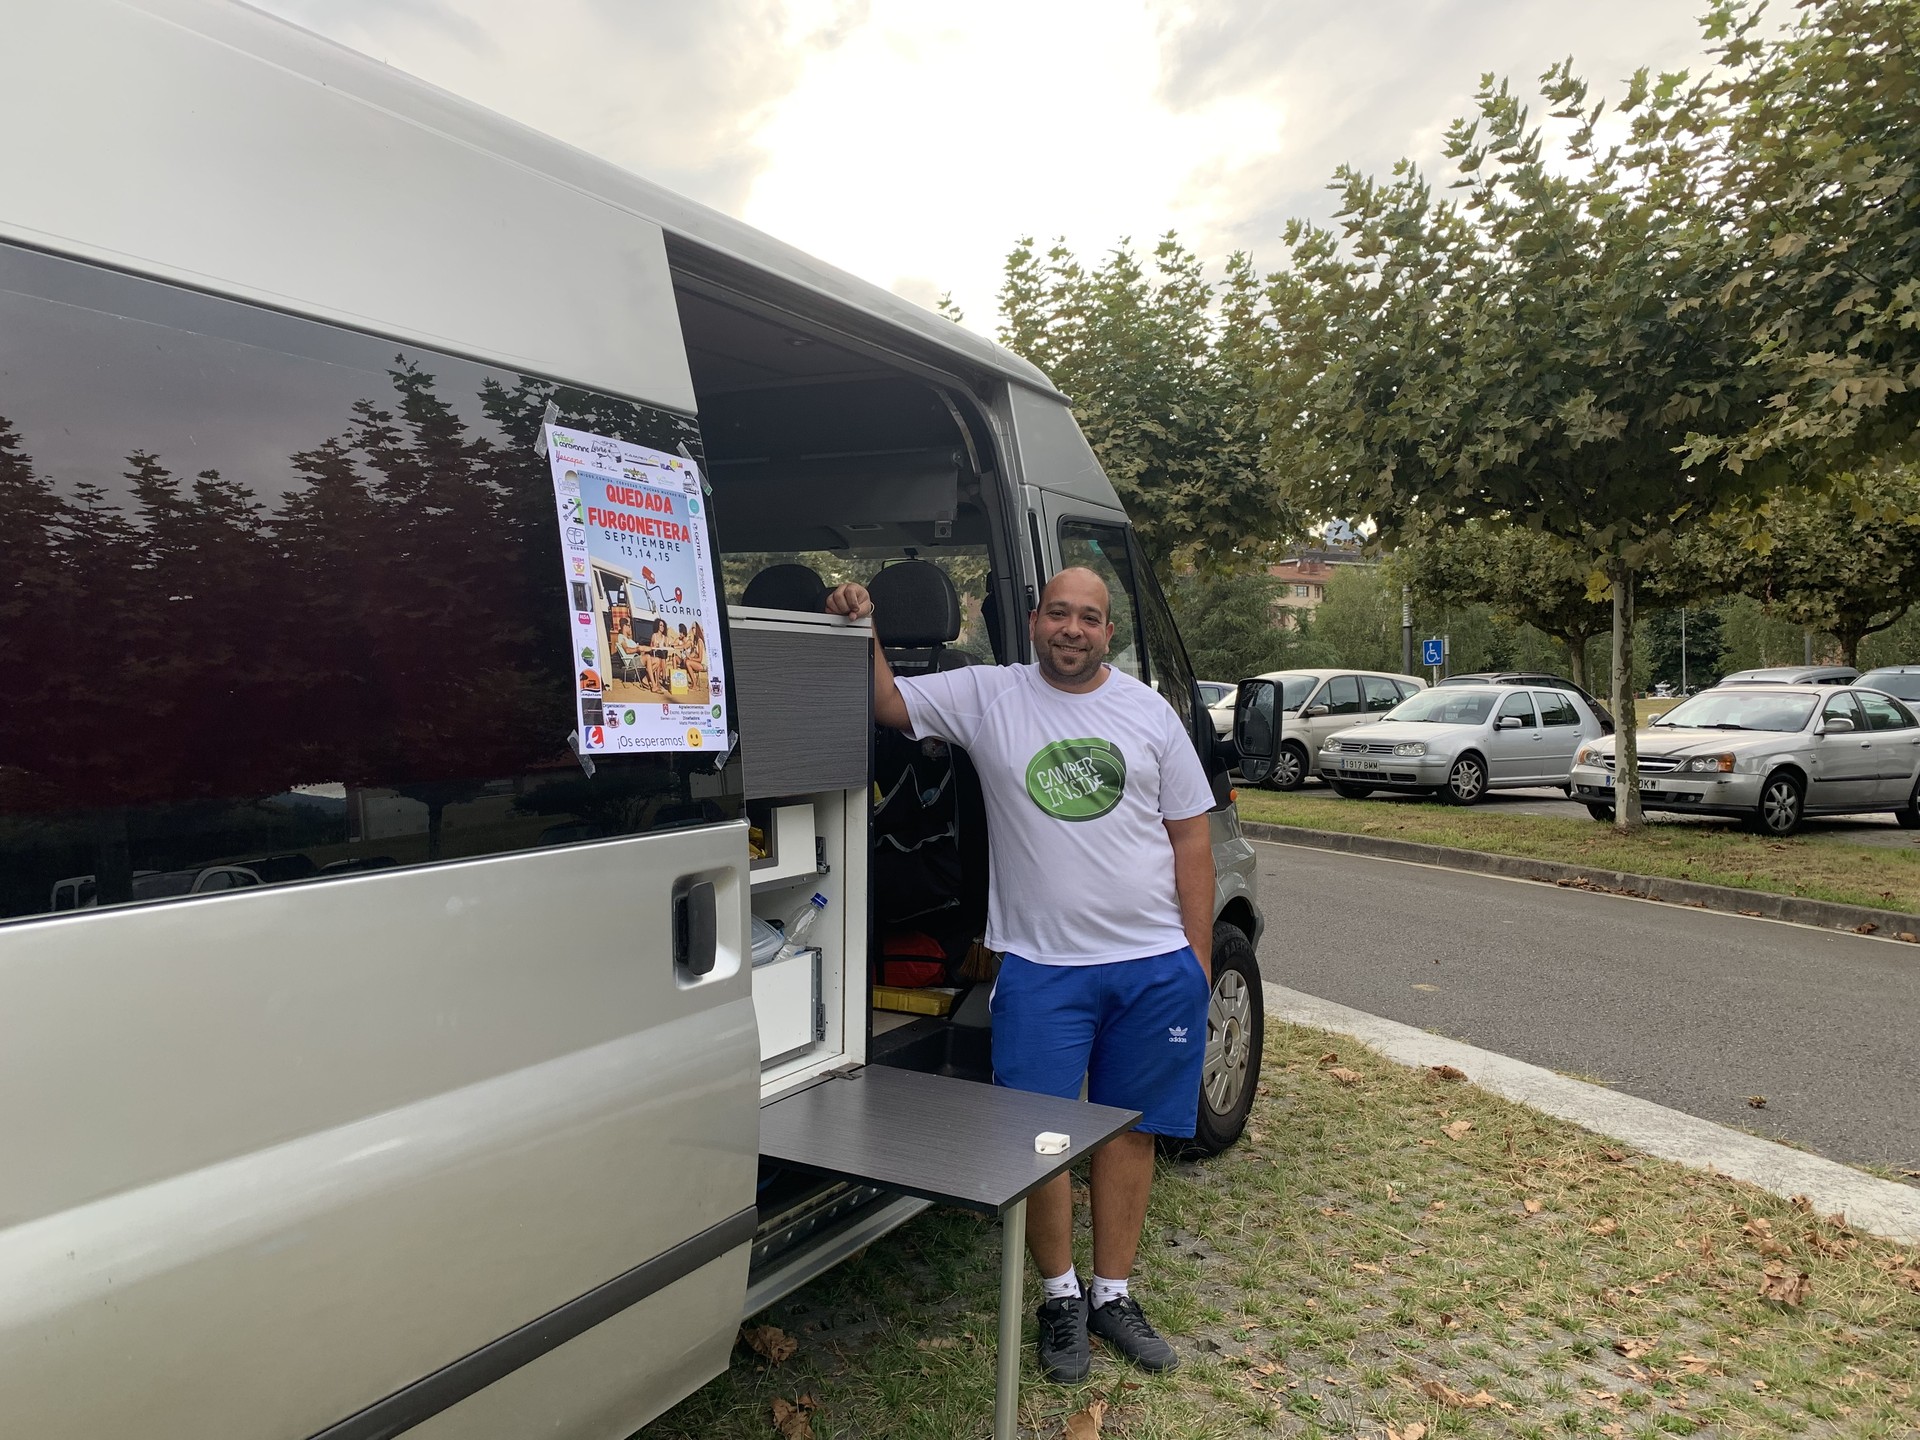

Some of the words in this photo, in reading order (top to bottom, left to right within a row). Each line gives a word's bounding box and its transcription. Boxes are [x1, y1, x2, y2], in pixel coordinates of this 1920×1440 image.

[606, 484, 673, 515] QUEDADA
[588, 507, 691, 543] FURGONETERA
[604, 530, 681, 552] SEPTIEMBRE
[660, 604, 702, 617] ELORRIO
[635, 735, 685, 749] esperamos!
[1037, 757, 1098, 790] CAMPER
[1045, 774, 1104, 808] INSIDE
